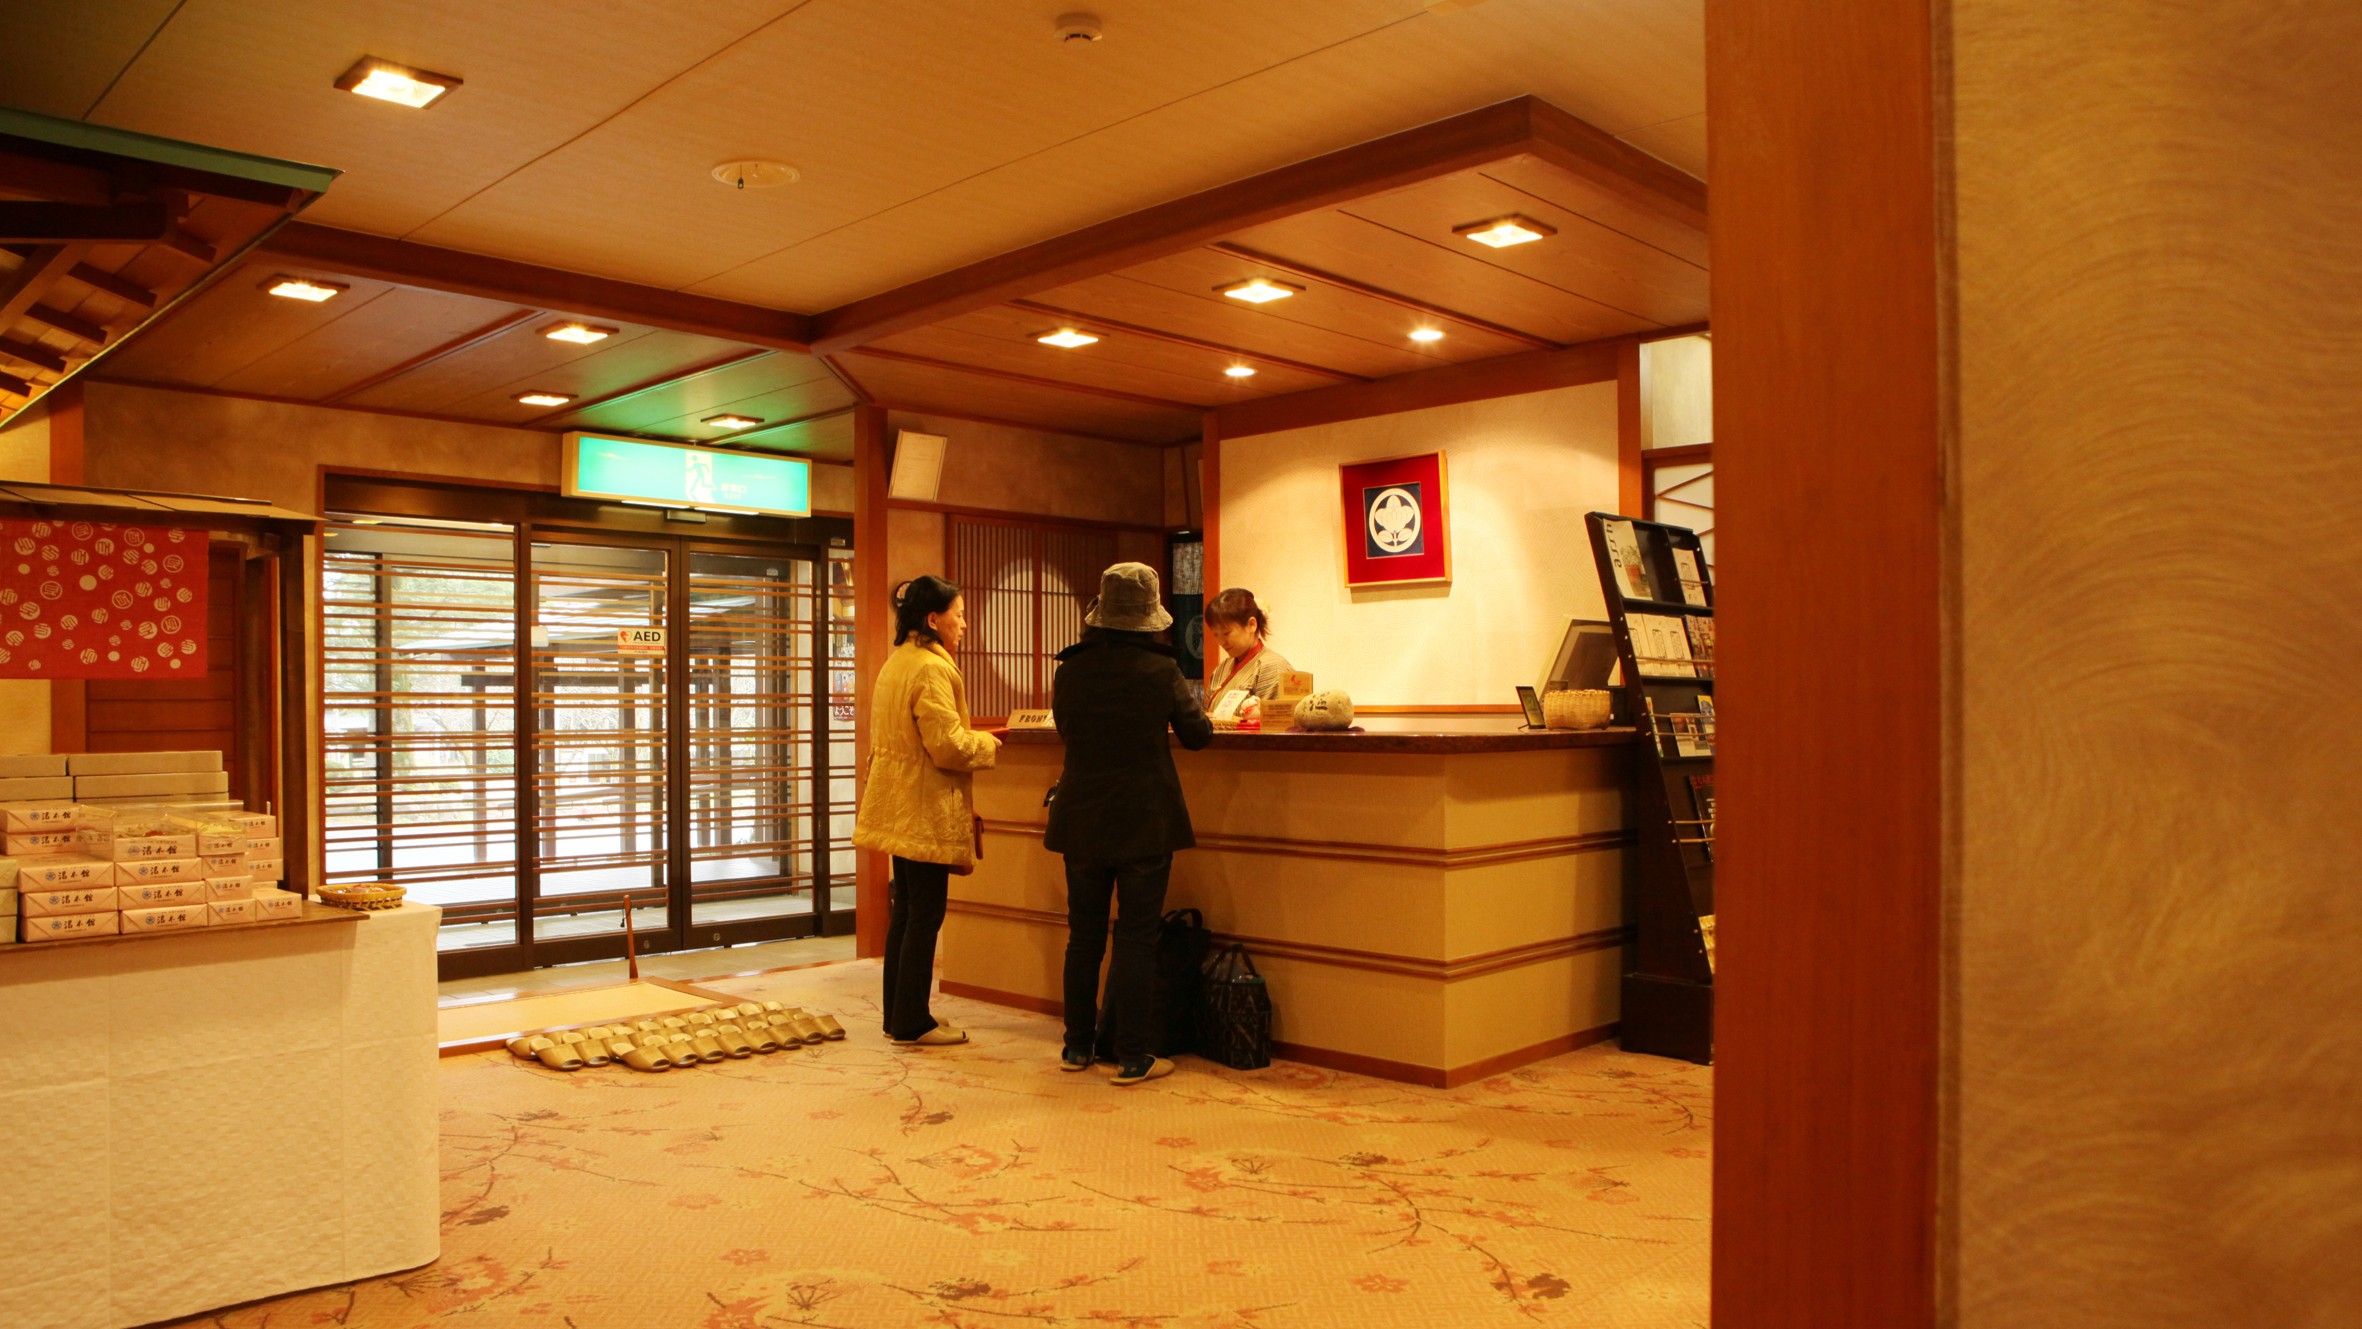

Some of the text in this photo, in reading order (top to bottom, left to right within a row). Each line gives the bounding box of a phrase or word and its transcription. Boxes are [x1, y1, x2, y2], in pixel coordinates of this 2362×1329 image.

[633, 631, 661, 642] AED
[834, 705, 855, 716] ようこそ
